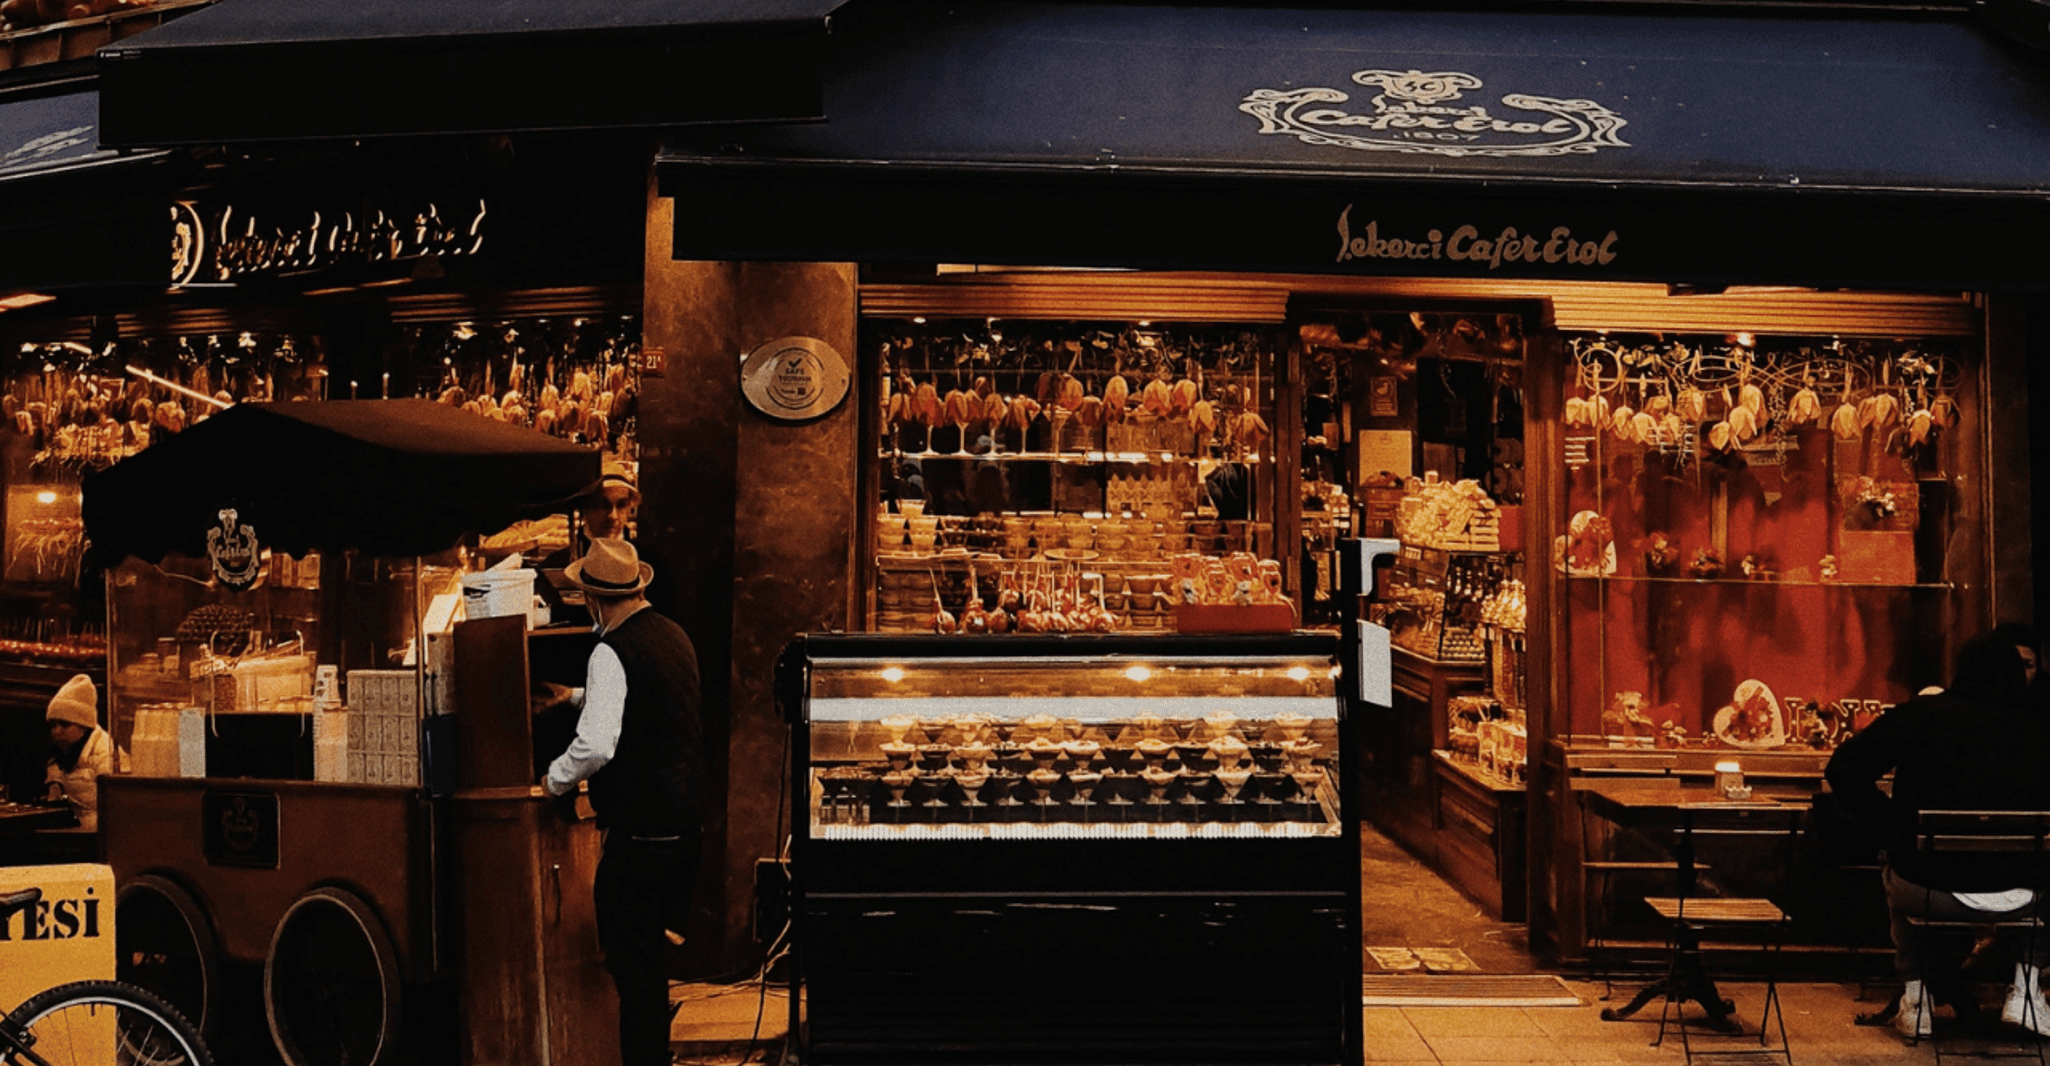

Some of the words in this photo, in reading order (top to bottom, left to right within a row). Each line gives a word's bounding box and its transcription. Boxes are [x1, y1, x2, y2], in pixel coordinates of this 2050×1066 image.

[1299, 109, 1452, 130] Cafer
[1452, 115, 1572, 133] Erol
[1445, 224, 1543, 270] Cafer
[1542, 225, 1619, 266] Erol
